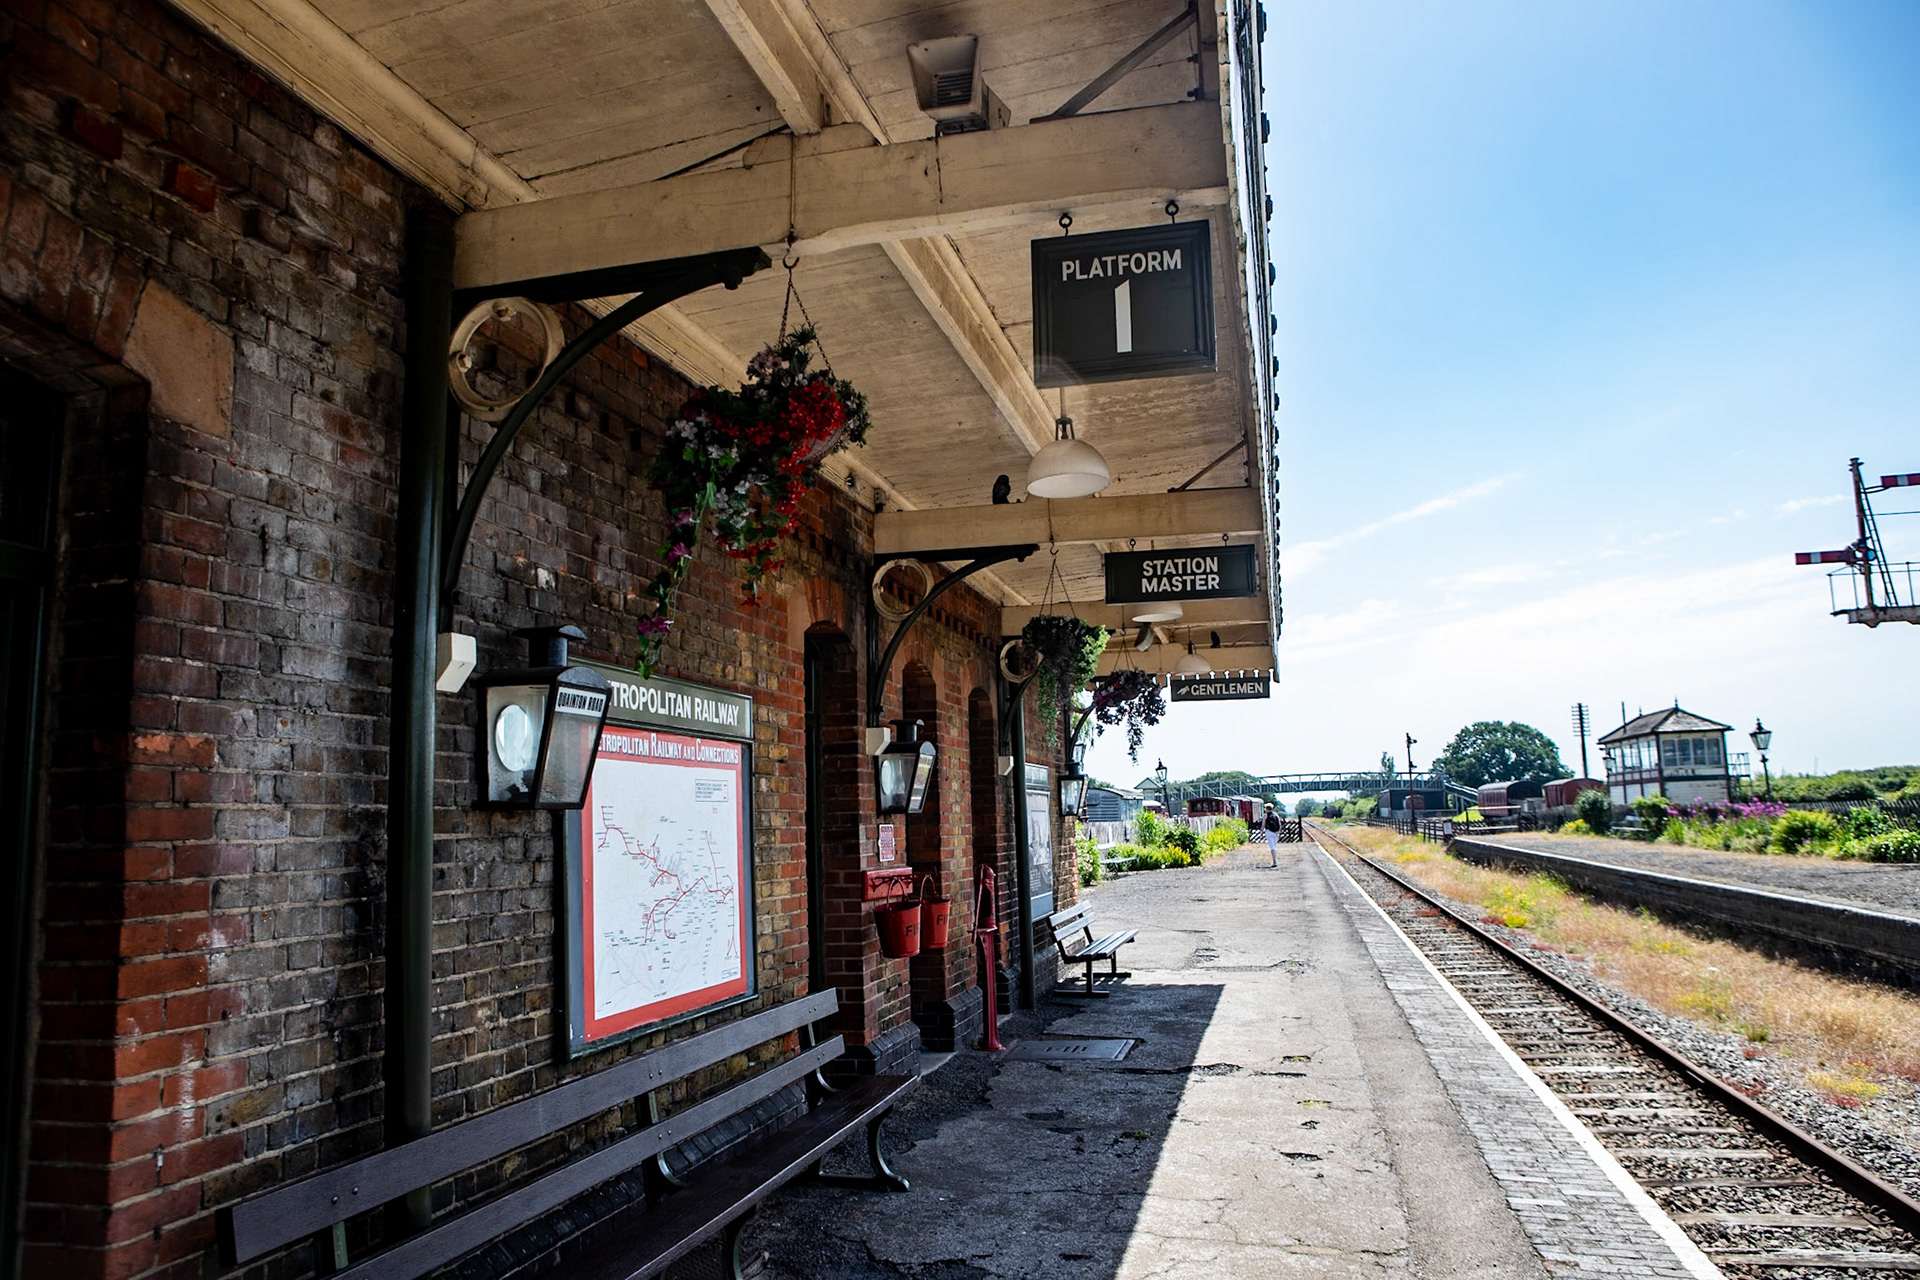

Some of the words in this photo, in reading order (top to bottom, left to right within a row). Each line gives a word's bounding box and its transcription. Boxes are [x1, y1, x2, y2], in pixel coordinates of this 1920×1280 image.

[1062, 249, 1182, 281] PLATFORM
[1115, 279, 1132, 353] 1
[1142, 556, 1218, 576] STATION
[1141, 574, 1219, 593] MASTER
[1191, 682, 1263, 695] GENTLEMEN
[557, 691, 588, 710] QUAINTON
[587, 696, 604, 713] ROAD
[607, 680, 692, 719] TROPOLITAN
[694, 697, 739, 726] RAILWAY
[650, 733, 682, 759] RAILWAY
[683, 748, 695, 760] AND
[695, 738, 739, 764] CONNECTIONS
